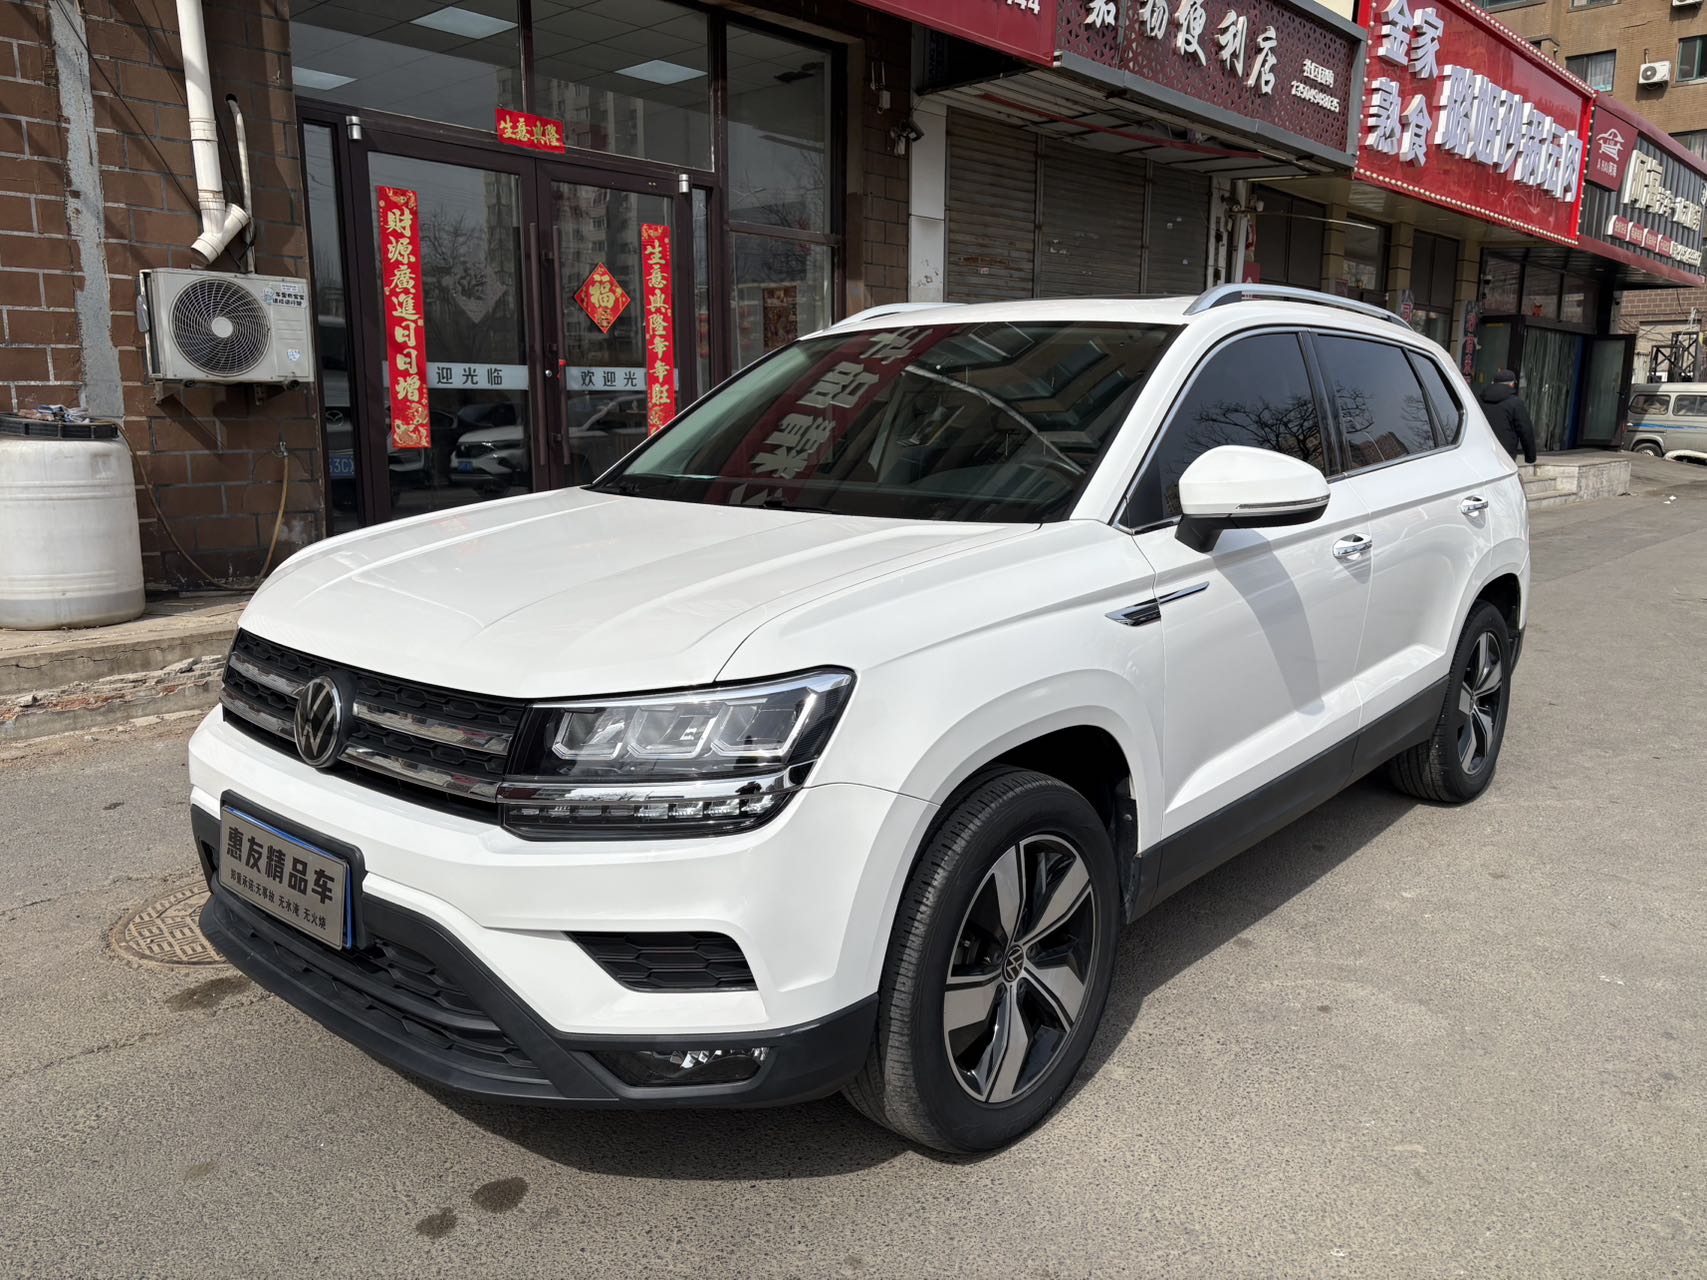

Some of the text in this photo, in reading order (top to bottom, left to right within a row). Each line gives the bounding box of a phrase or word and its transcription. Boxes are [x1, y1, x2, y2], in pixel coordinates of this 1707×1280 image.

[1377, 0, 1444, 78] 金家
[1365, 77, 1432, 167] 熟食
[589, 274, 616, 309] 福
[437, 366, 503, 386] 迎光临
[580, 370, 649, 388] 欢迎光
[226, 826, 336, 905] 惠友精品车
[303, 908, 327, 930] 无火烧
